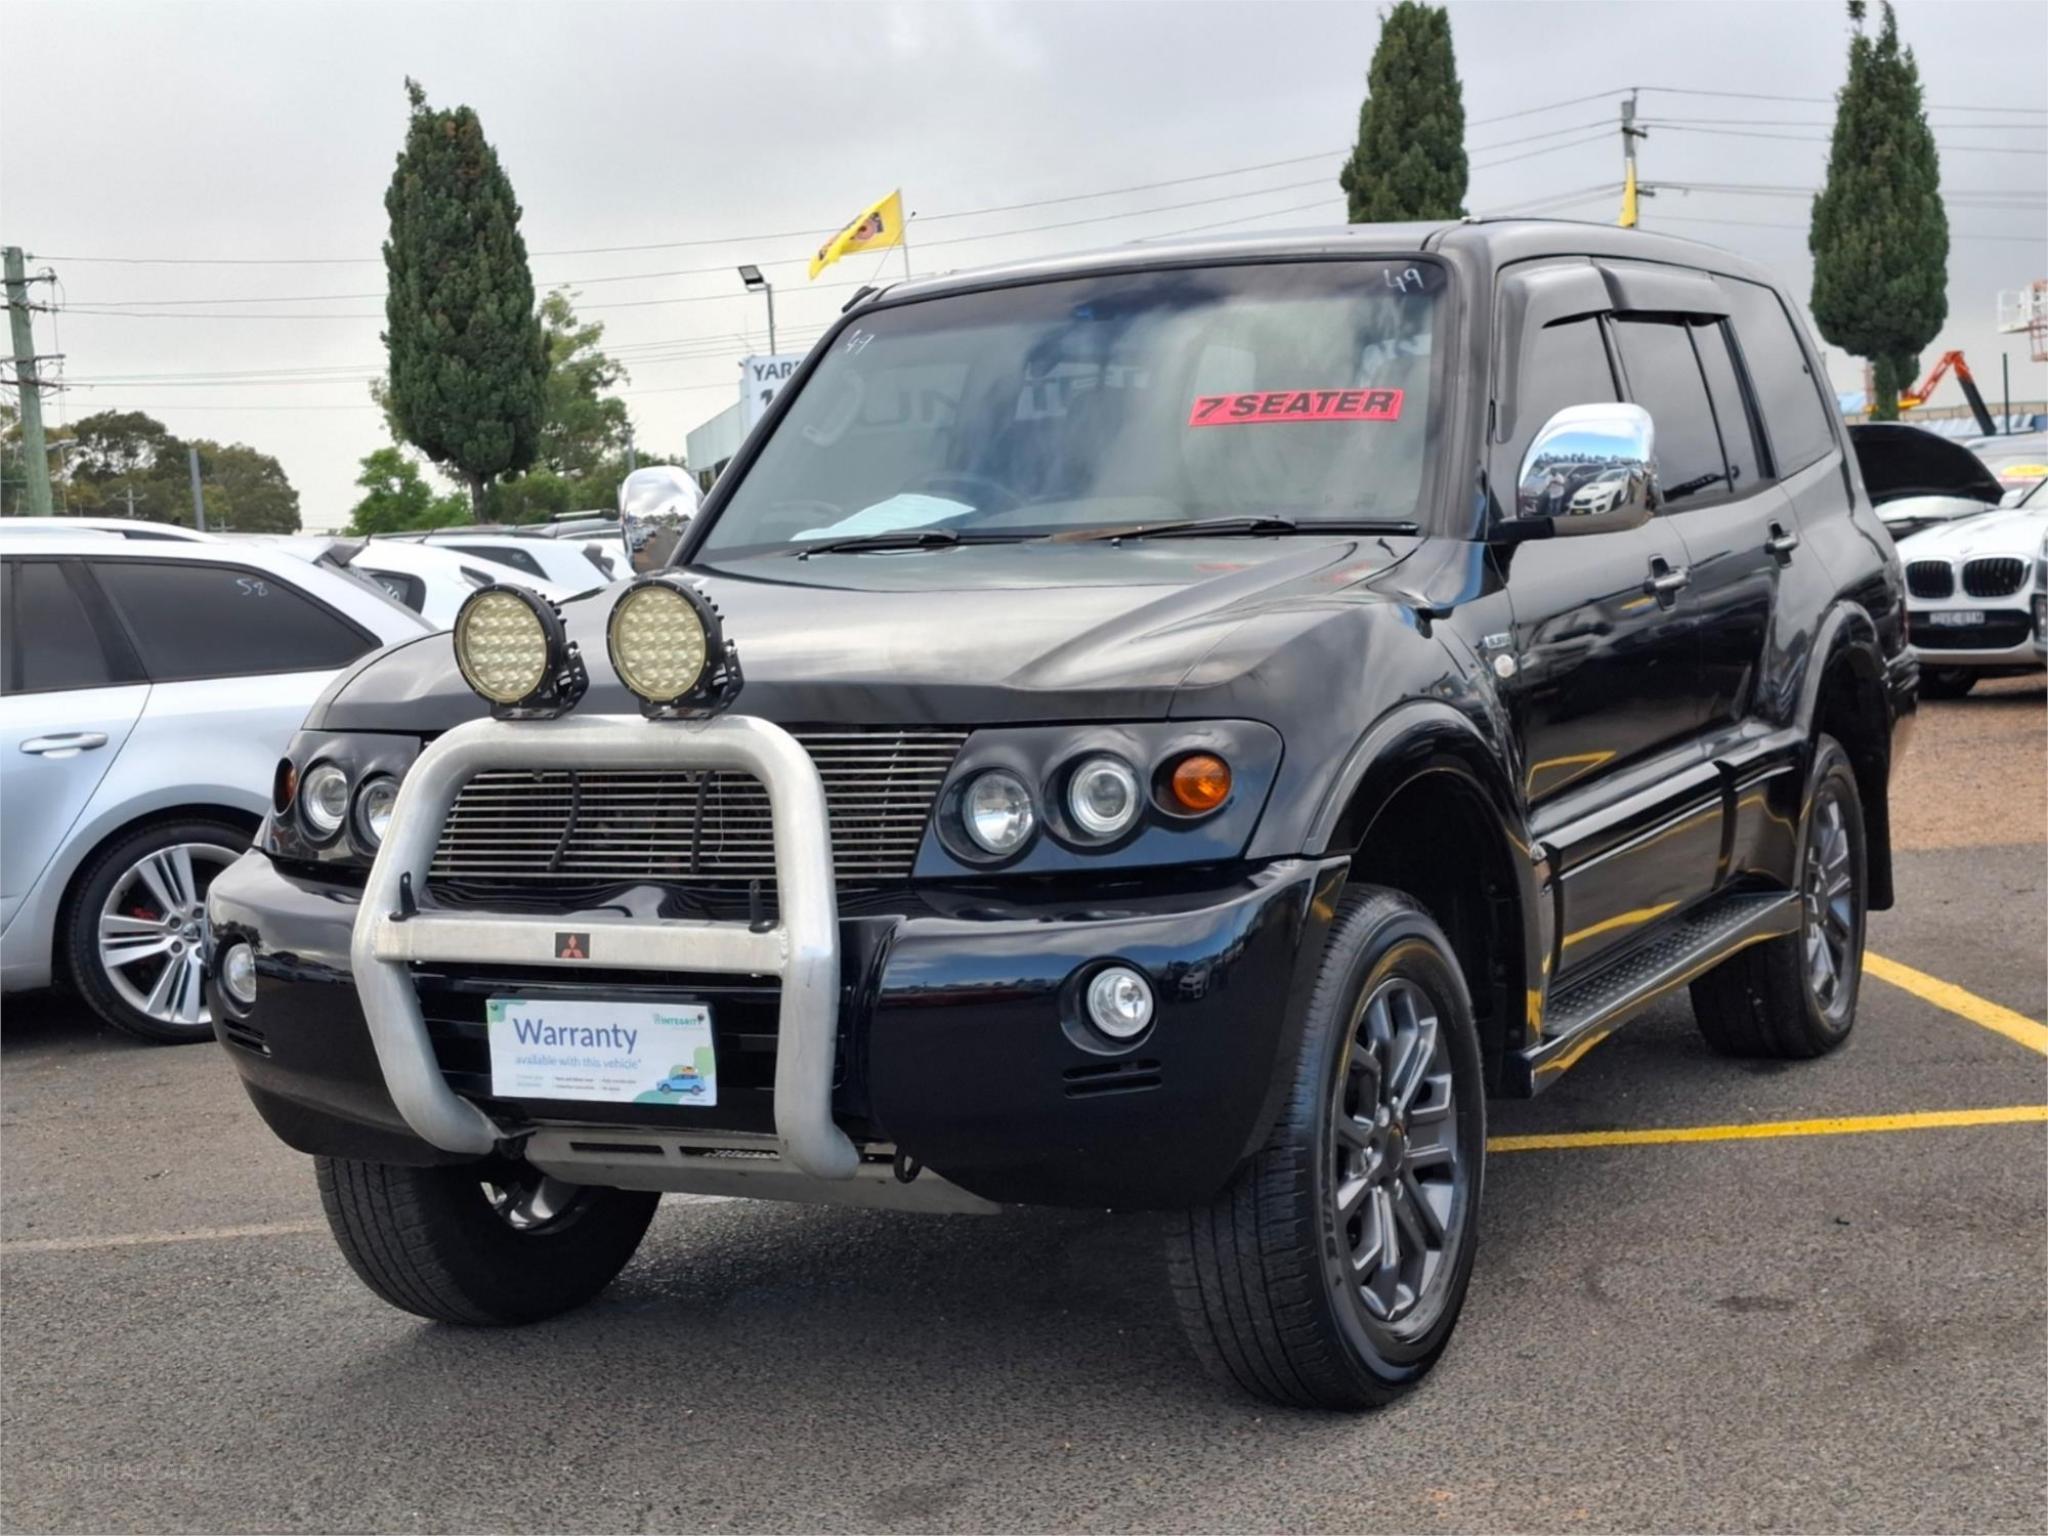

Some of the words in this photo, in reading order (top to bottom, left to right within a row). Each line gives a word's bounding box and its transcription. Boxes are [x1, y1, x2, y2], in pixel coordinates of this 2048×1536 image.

[1383, 267, 1424, 292] 49
[752, 361, 800, 381] YAR
[1197, 397, 1226, 418] 7
[1229, 391, 1396, 417] SEATER
[236, 578, 269, 597] 58
[512, 1017, 637, 1055] Warranty
[515, 1053, 556, 1066] available
[559, 1055, 582, 1068] with
